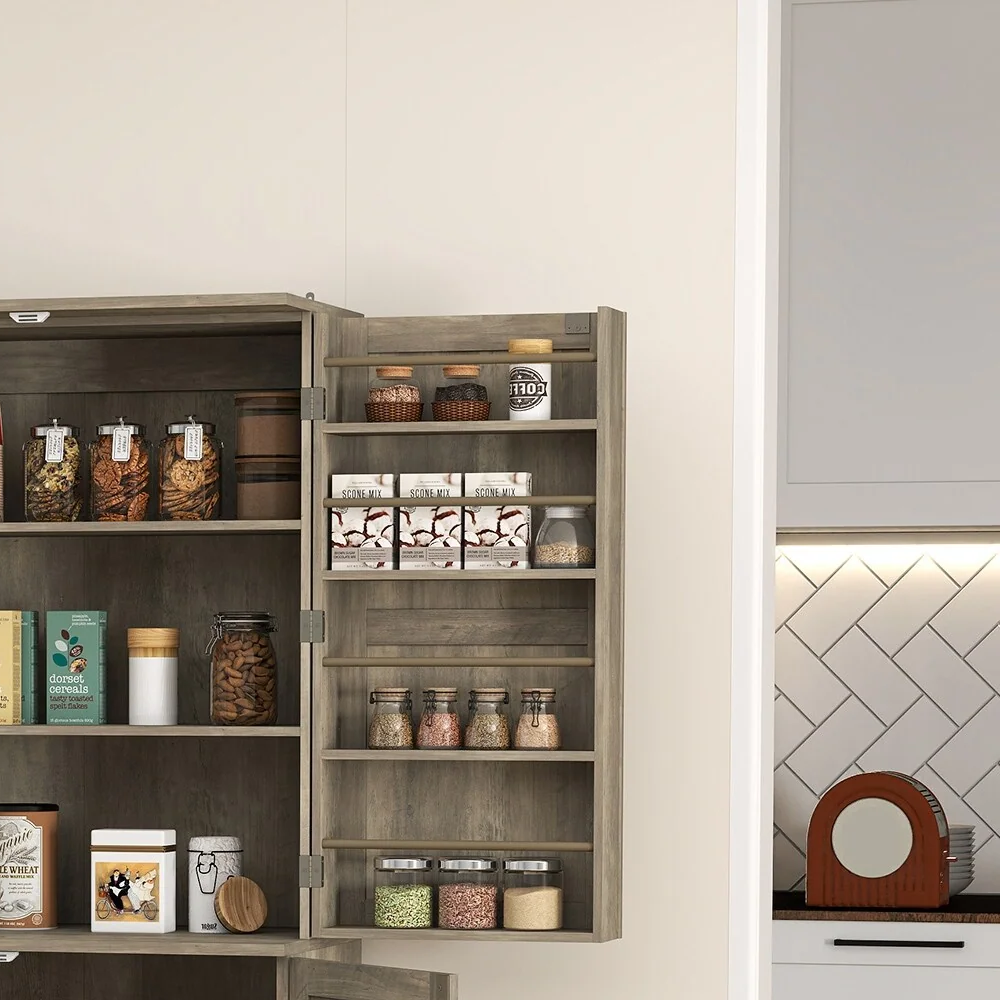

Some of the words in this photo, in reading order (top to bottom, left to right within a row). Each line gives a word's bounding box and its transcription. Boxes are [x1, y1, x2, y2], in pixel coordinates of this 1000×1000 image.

[342, 489, 365, 498] SCONE
[369, 490, 382, 498] MIX
[410, 489, 433, 498] SCONE
[437, 489, 450, 498] MIX
[475, 488, 499, 496] SCONE
[502, 488, 515, 496] MIX
[50, 674, 84, 683] dorset
[50, 684, 88, 693] cereals
[10, 865, 39, 874] WHEAT
